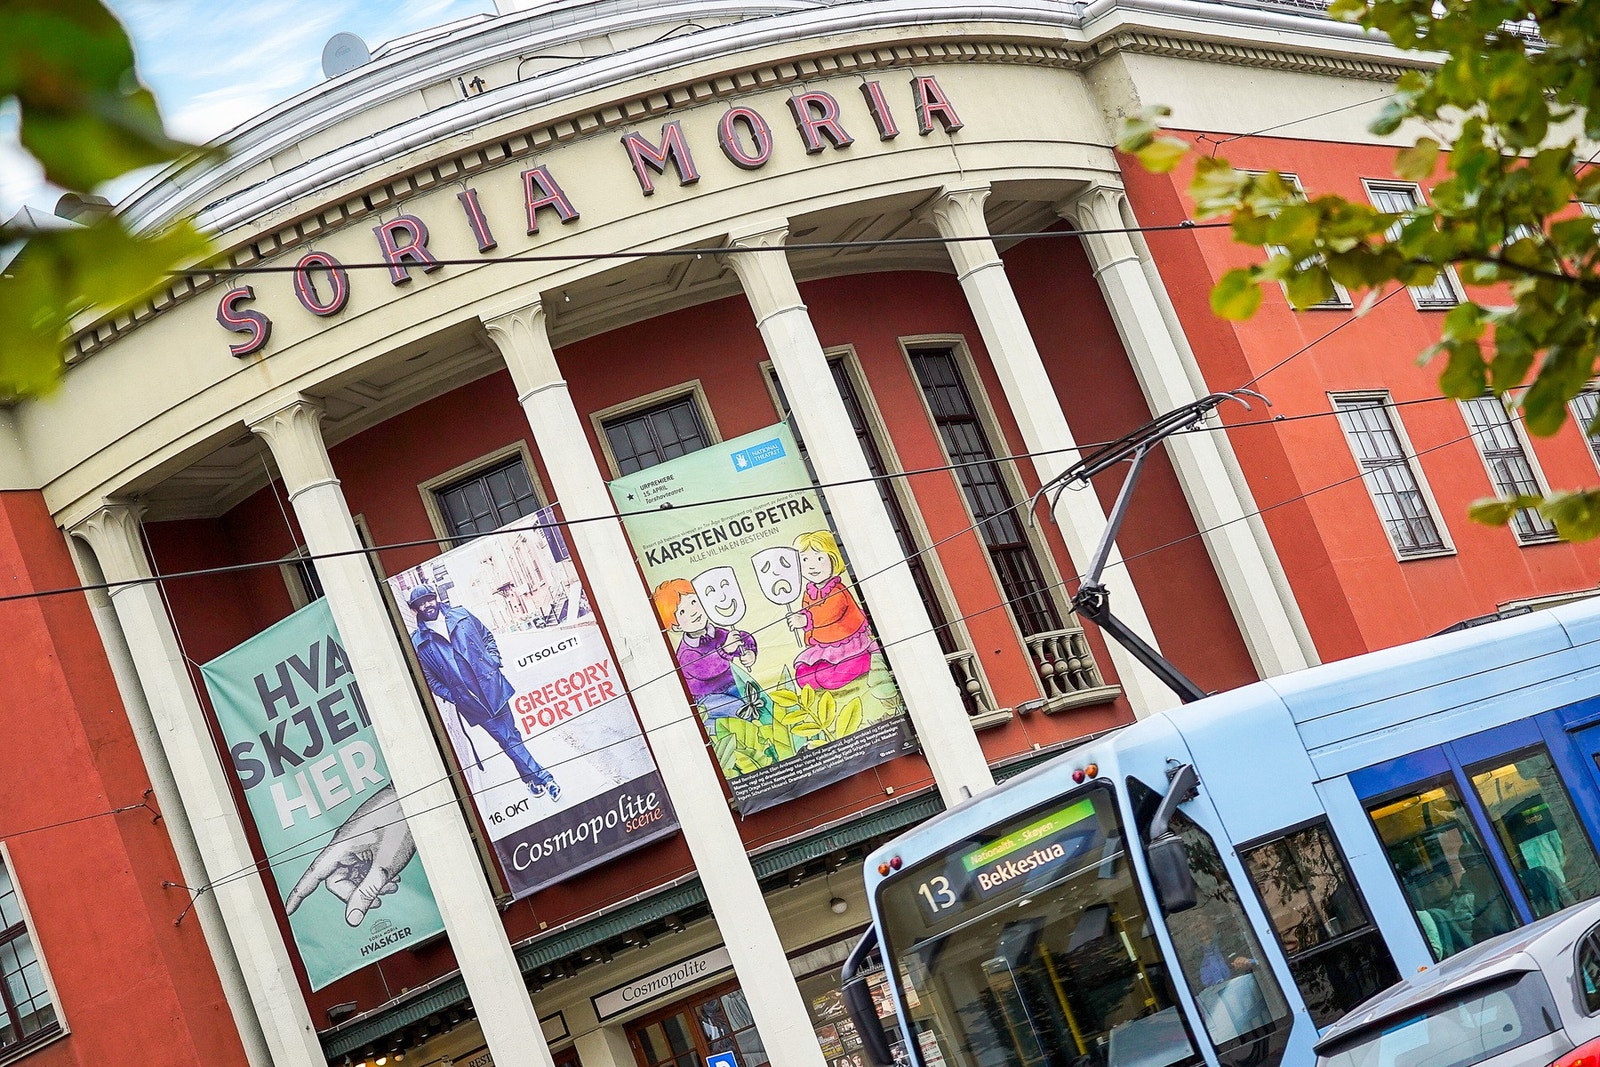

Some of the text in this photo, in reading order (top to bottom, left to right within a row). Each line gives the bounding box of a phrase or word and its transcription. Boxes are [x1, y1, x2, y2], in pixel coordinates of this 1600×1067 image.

[217, 76, 964, 357] SORIA MORIA
[751, 444, 779, 457] NATIONAL
[640, 474, 674, 490] URPREMIERE
[652, 485, 668, 495] APRIL
[645, 496, 814, 567] KARSTEN OG PETRA
[688, 526, 779, 563] ALLE VIL HA EN BESTEVENN
[517, 636, 579, 668] UTSOLGT!
[253, 634, 354, 721] HVA
[515, 659, 611, 715] GREGORY
[521, 679, 618, 735] PORTER
[269, 740, 386, 831] HER
[488, 799, 530, 826] 16. OKT
[511, 789, 660, 872] Cosmopolite
[626, 806, 663, 834] scene
[977, 842, 1065, 891] Bekkestua
[918, 876, 956, 913] 13
[360, 927, 412, 956] HVASKJER
[622, 960, 707, 1001] Cosmopolite
